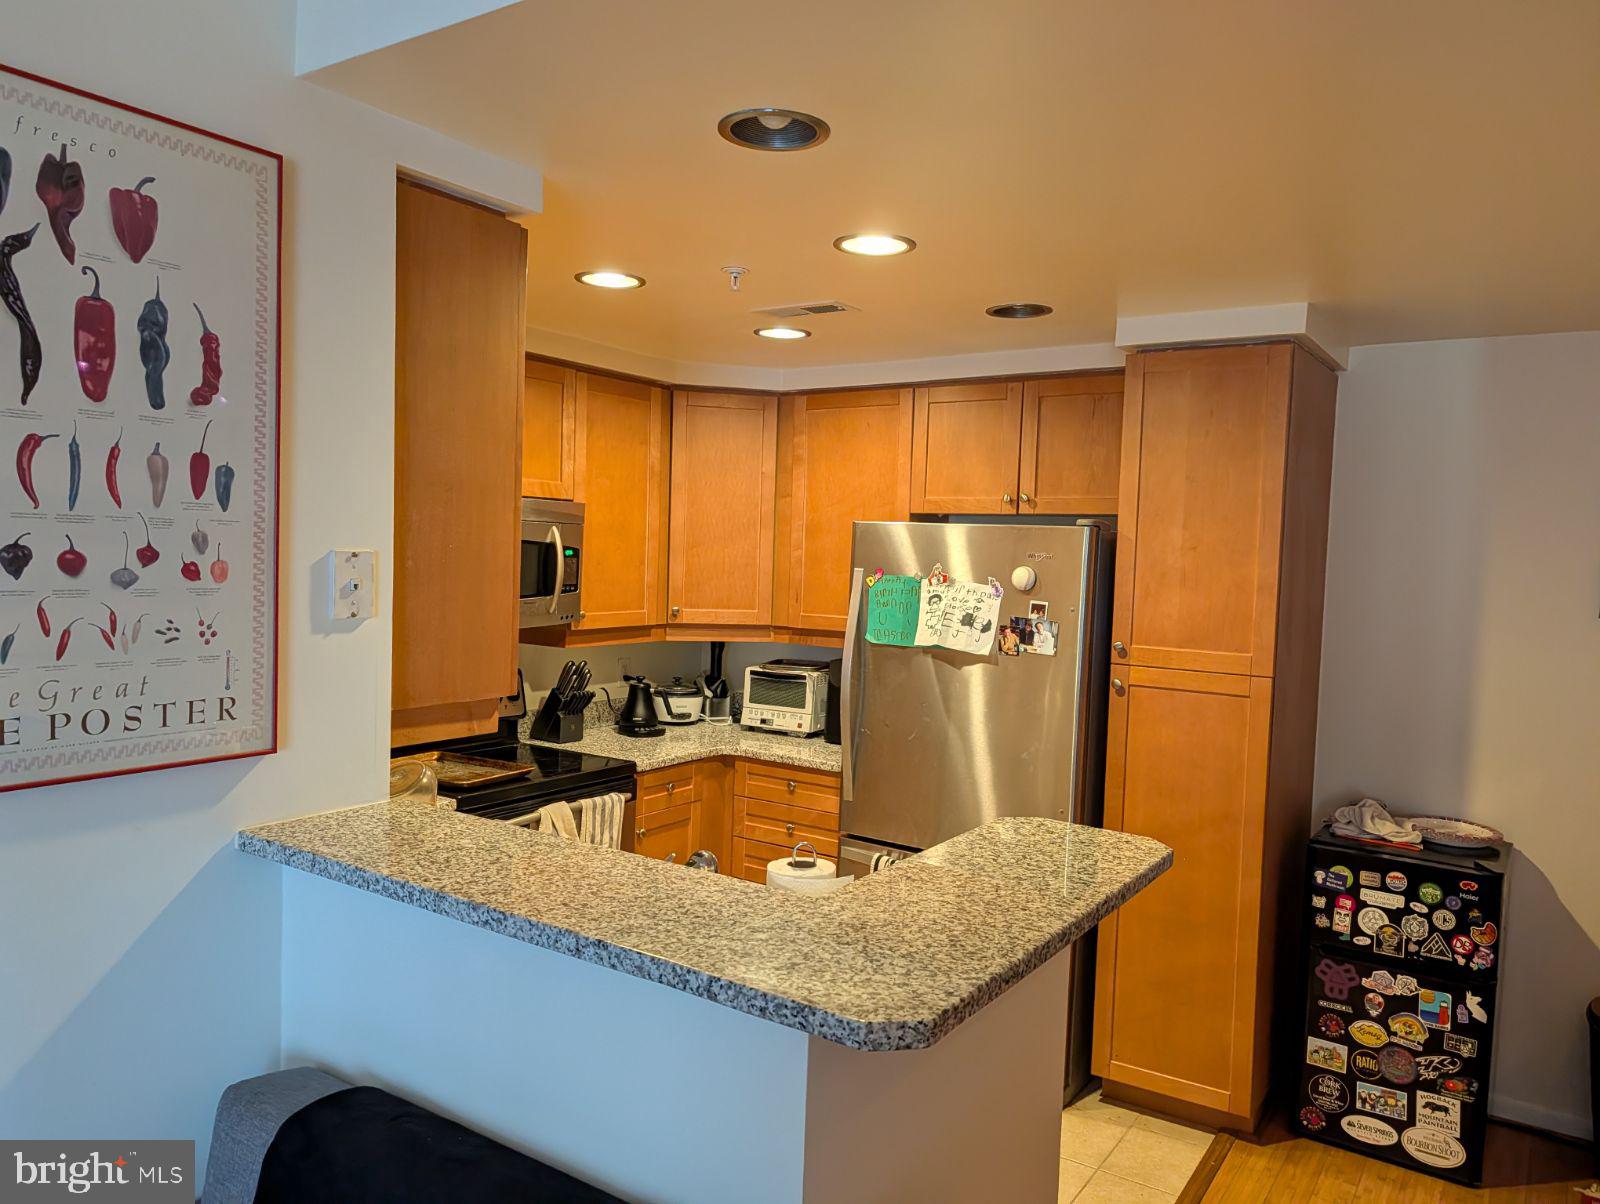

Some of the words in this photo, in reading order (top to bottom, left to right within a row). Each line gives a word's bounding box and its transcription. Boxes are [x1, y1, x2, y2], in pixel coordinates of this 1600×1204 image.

[14, 115, 117, 158] fresco
[38, 675, 149, 712] Great
[46, 696, 238, 741] POSTER
[1459, 892, 1480, 902] Haier
[1356, 1055, 1379, 1072] RATIO
